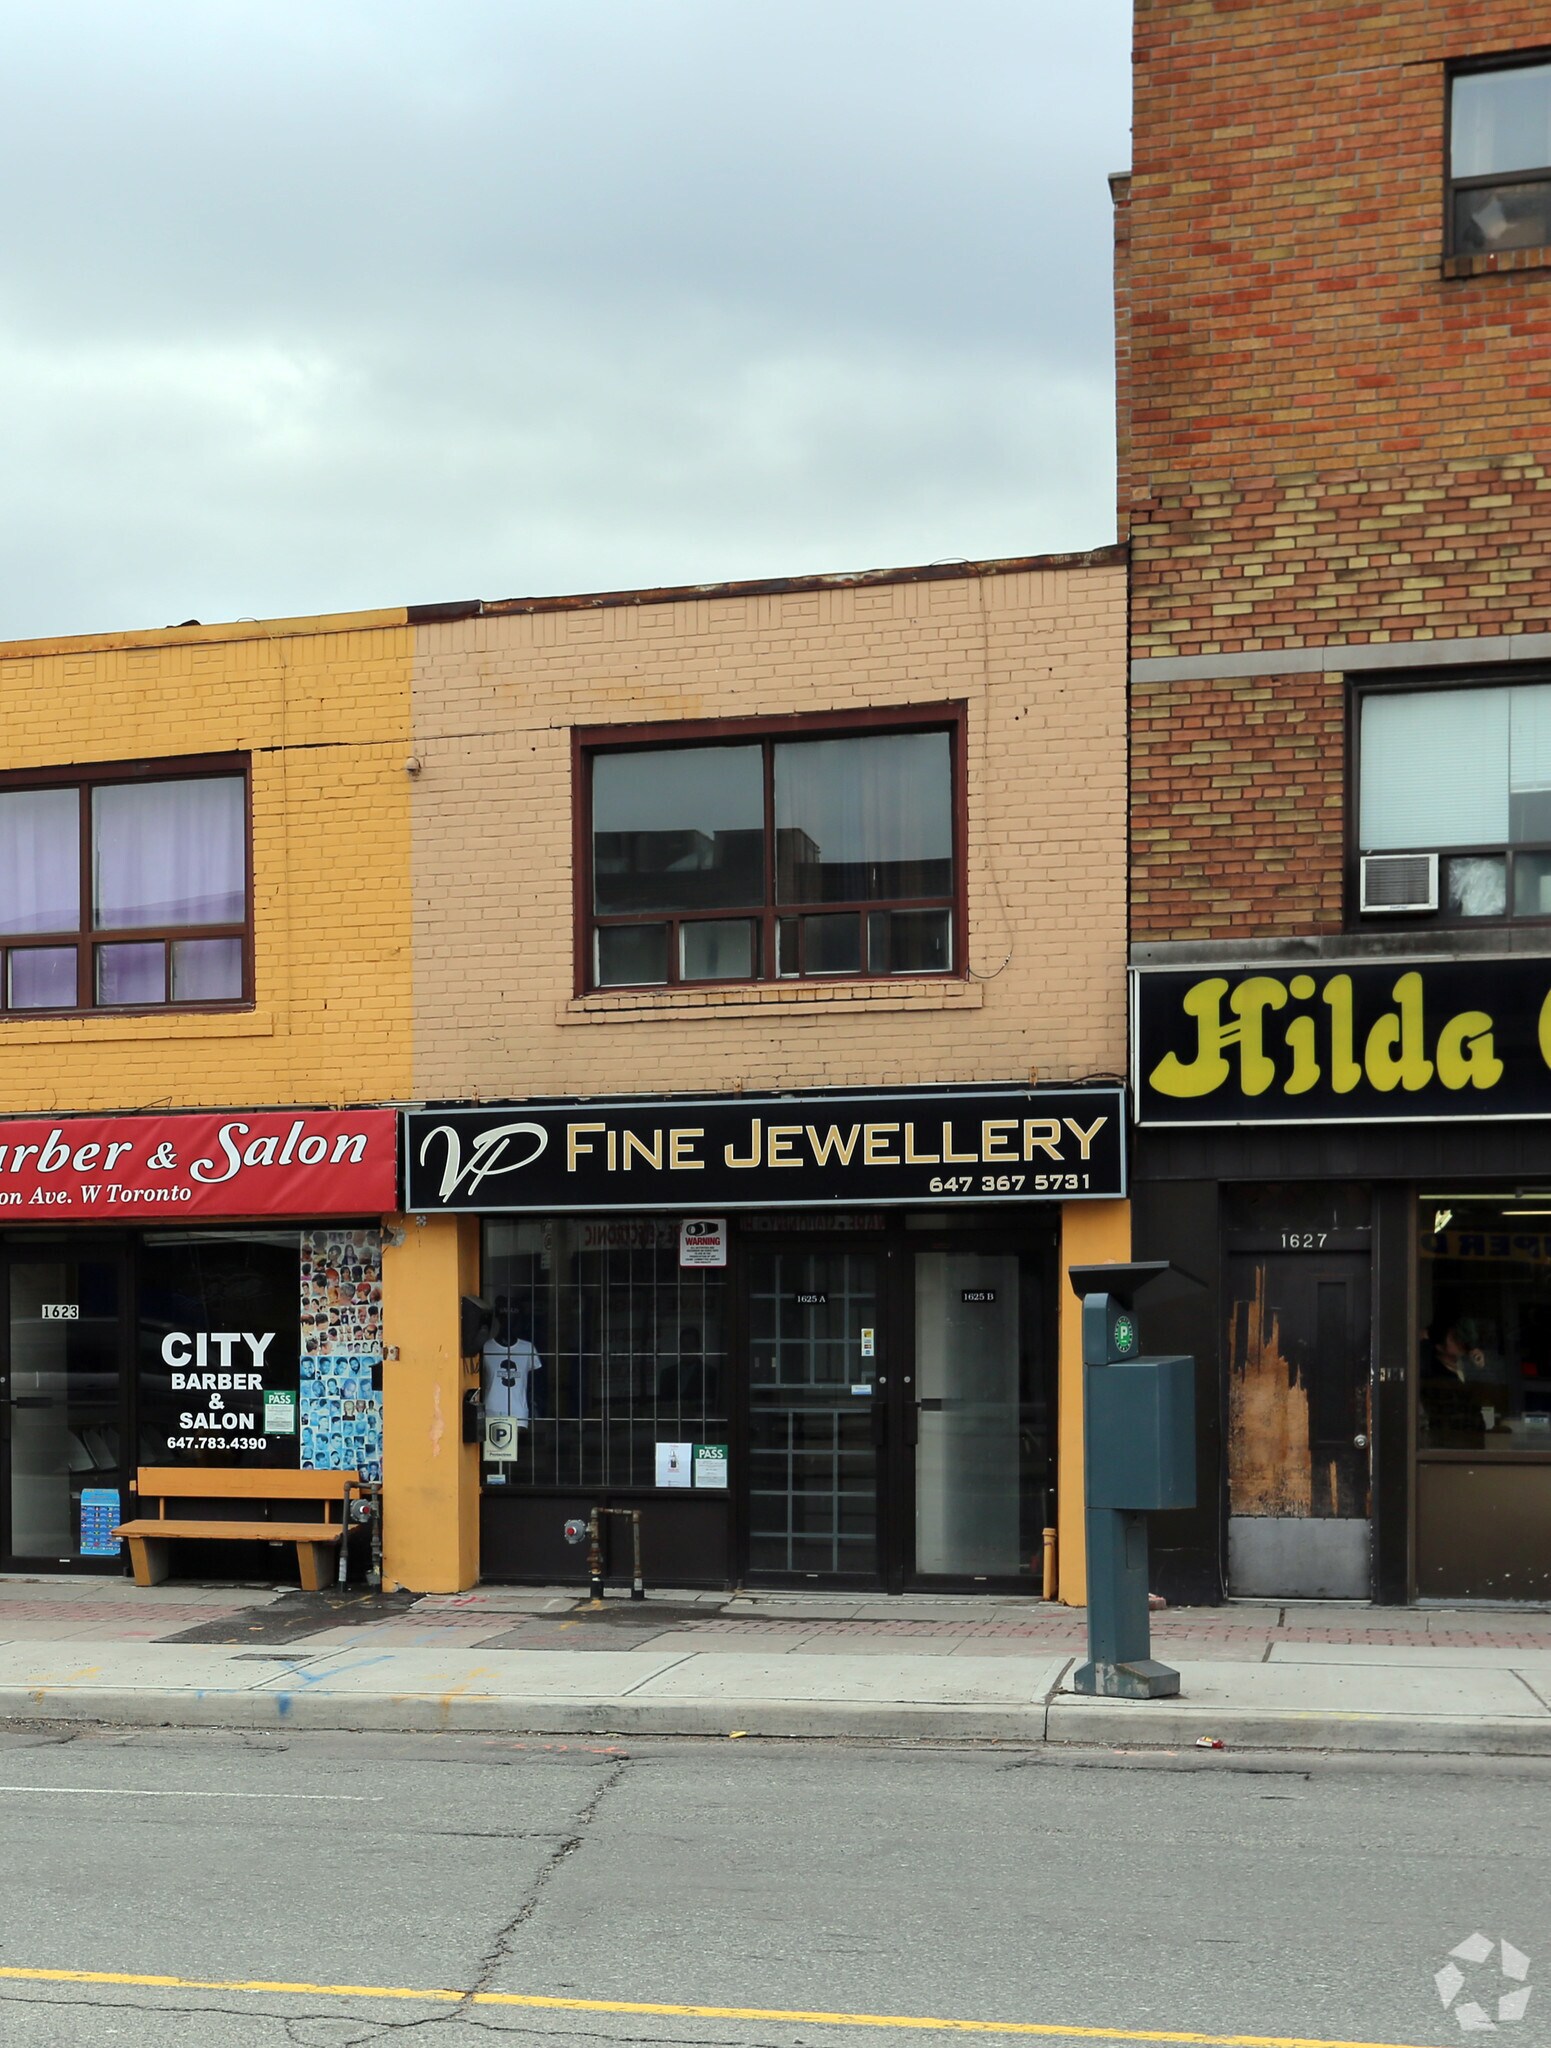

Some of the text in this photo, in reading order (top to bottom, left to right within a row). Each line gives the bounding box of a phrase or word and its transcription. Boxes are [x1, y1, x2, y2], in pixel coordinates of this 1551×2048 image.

[1149, 971, 1504, 1098] Hilda
[146, 1141, 178, 1170] &
[189, 1119, 369, 1184] Salon
[420, 1116, 1108, 1203] VP FINE JEWELLERY
[929, 1174, 1091, 1193] 647 367 5731
[28, 1187, 73, 1205] Ave.
[81, 1184, 103, 1204] W
[106, 1184, 192, 1204] Toronto
[685, 1237, 721, 1246] WARNING
[1281, 1233, 1328, 1249] 1627
[797, 1295, 826, 1303] 1625 A
[964, 1293, 994, 1301] 1625 B
[44, 1305, 78, 1318] 1623
[1120, 1325, 1128, 1340] P
[161, 1332, 276, 1367] CITY
[171, 1373, 264, 1390] BARBER
[208, 1393, 225, 1410] &
[268, 1395, 291, 1404] PASS
[179, 1412, 255, 1430] SALON
[167, 1437, 267, 1449] 647.783.4390
[496, 1428, 508, 1442] P
[699, 1449, 724, 1459] PASS
